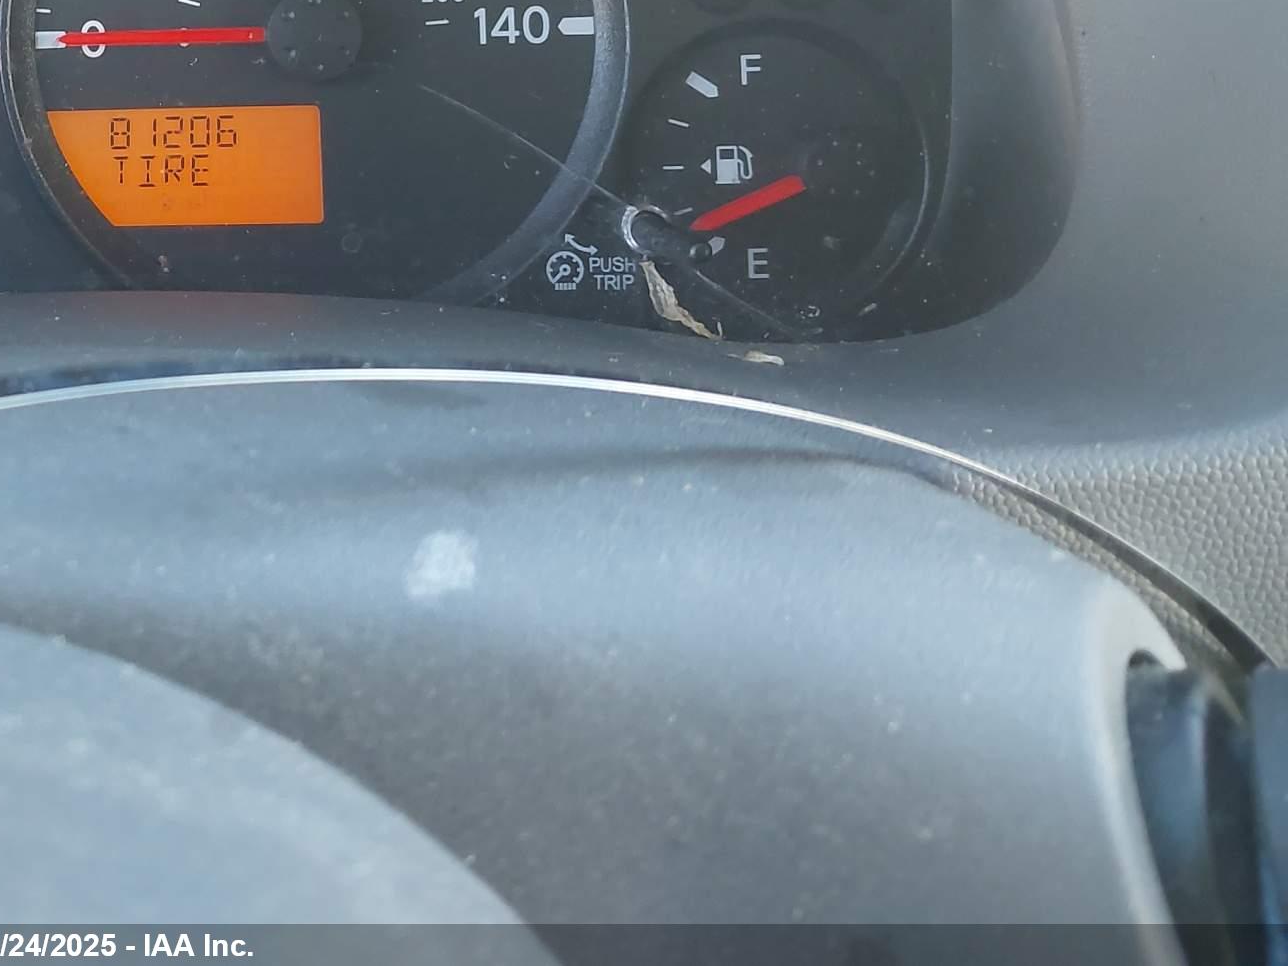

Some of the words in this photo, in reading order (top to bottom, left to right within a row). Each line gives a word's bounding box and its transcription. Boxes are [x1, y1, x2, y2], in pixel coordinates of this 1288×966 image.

[473, 5, 550, 45] 140
[740, 54, 762, 86] F
[110, 115, 238, 150] 81206
[112, 154, 210, 187] TIRE
[588, 257, 637, 274] PUSH
[747, 247, 770, 279] E
[593, 274, 635, 292] TRIP
